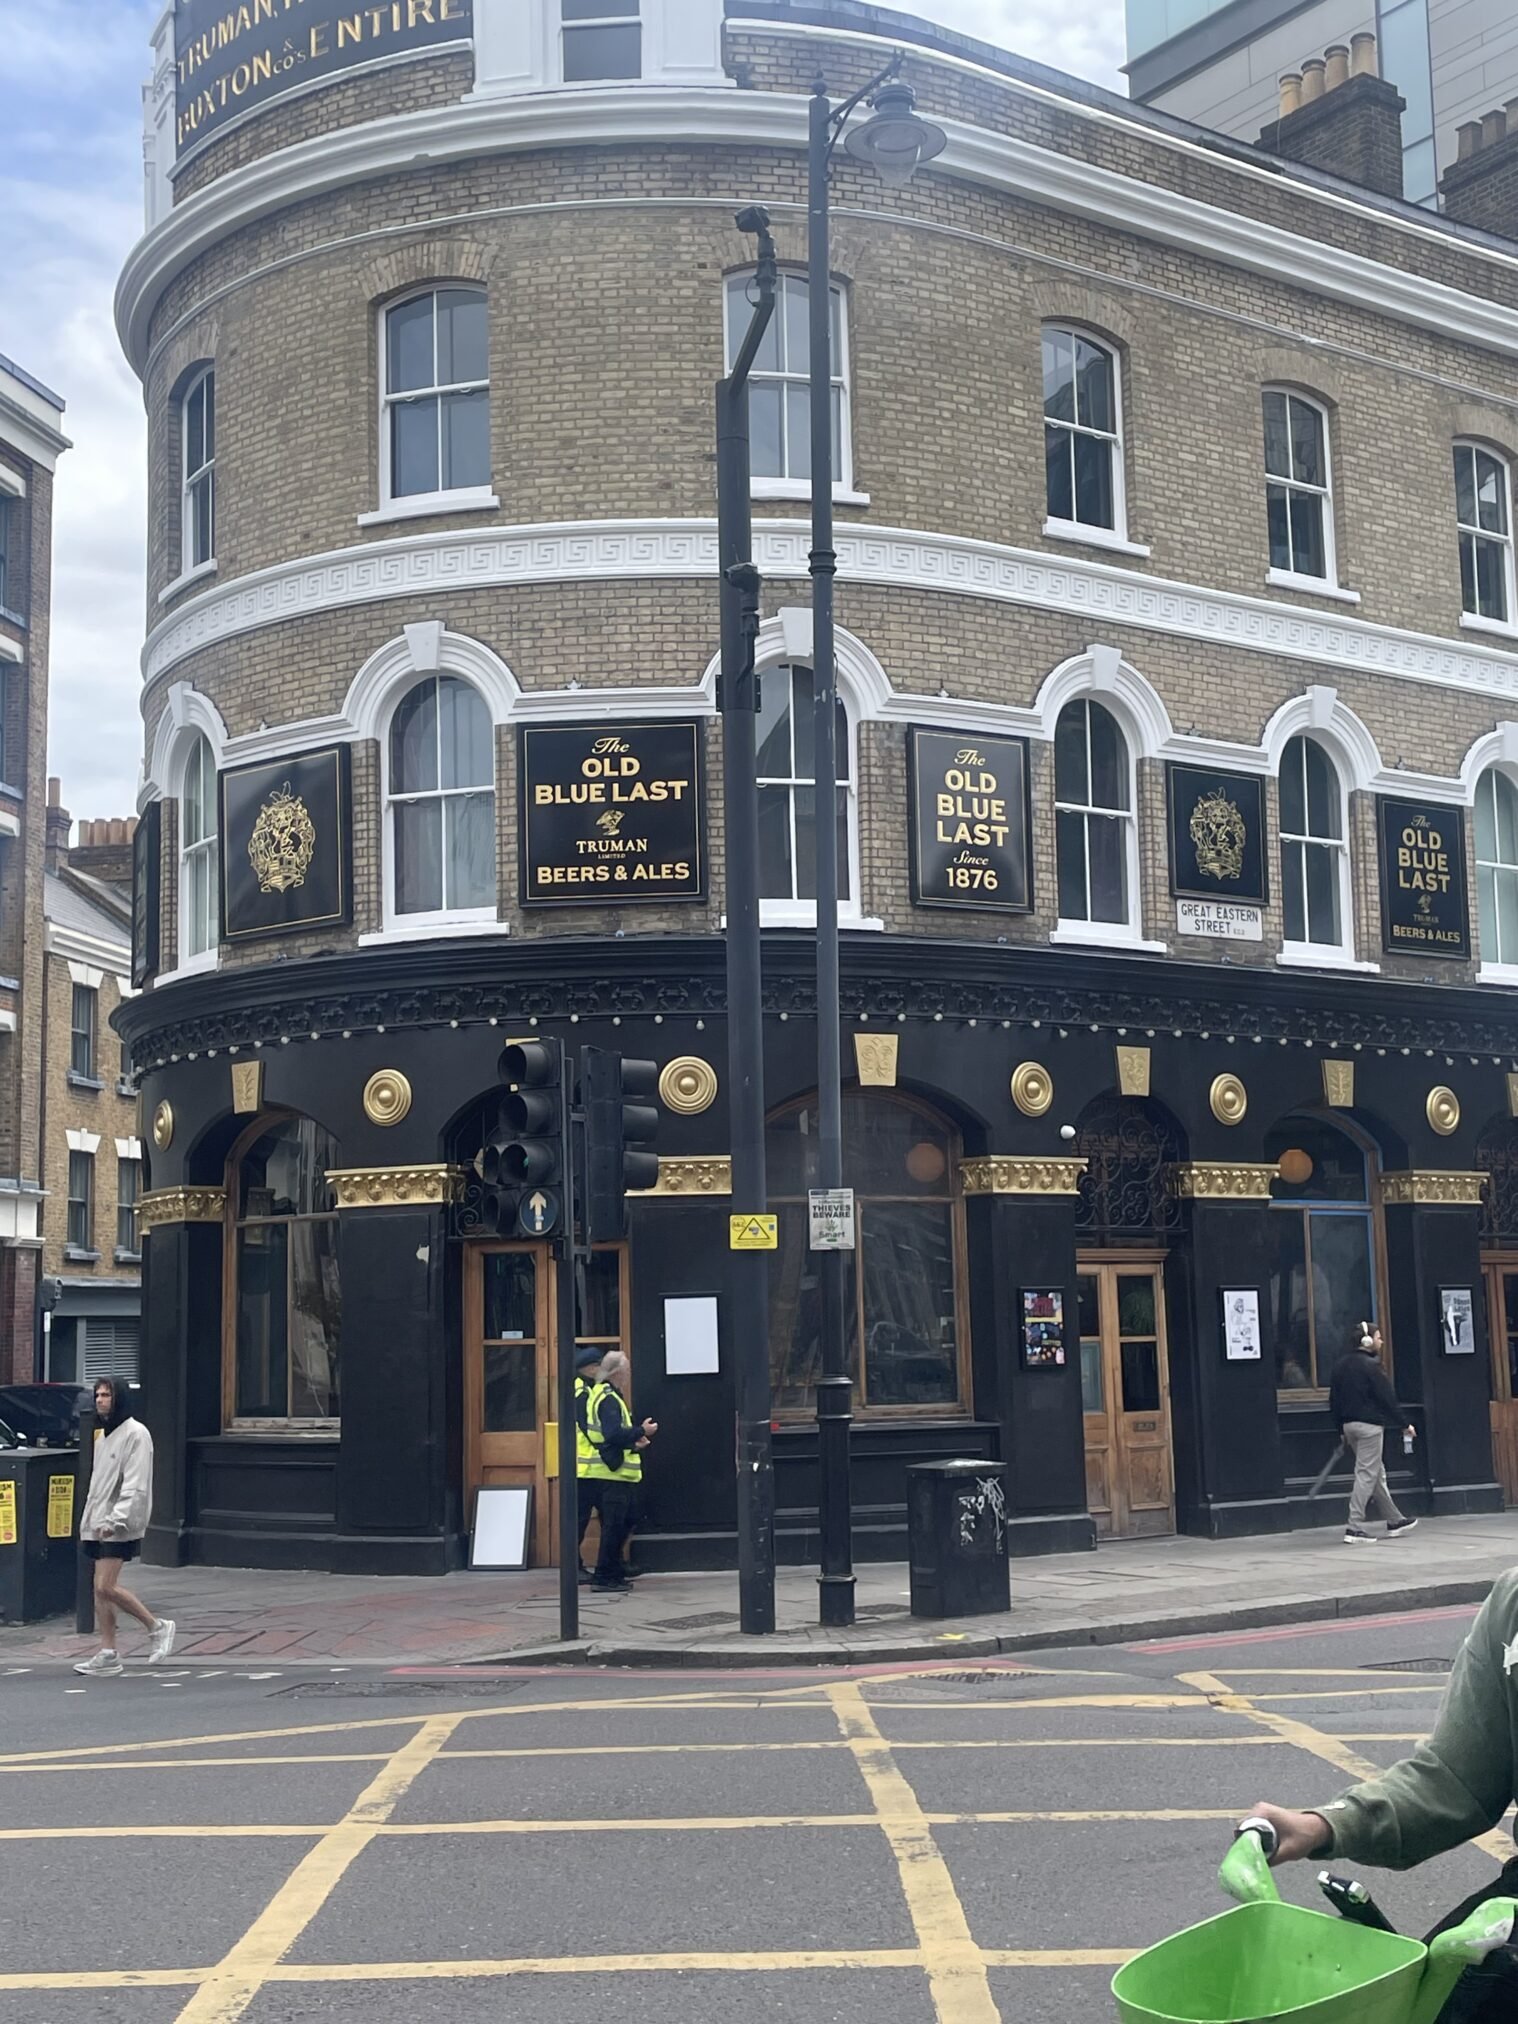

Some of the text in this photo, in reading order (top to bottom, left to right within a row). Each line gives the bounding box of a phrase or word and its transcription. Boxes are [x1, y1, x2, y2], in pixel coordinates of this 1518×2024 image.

[591, 736, 630, 755] The
[954, 749, 986, 766] The
[581, 757, 641, 778] OLD
[944, 770, 997, 794] OLD
[535, 780, 688, 805] BLUE LAST
[937, 794, 1007, 822] BLUE
[1410, 815, 1431, 828] The
[936, 820, 1009, 847] LAST
[1402, 828, 1442, 850] OLD
[576, 838, 648, 853] TRUMAN
[953, 850, 989, 865] Since
[1398, 848, 1449, 872] BLUE
[537, 862, 690, 884] BEERS & ALES
[945, 867, 998, 890] 1876
[1399, 870, 1450, 893] LAST
[1181, 904, 1258, 922] GREAT EASTERN
[1194, 918, 1231, 934] STREET
[1393, 925, 1460, 943] BEERS & ALES
[812, 1204, 851, 1212] THIEVES
[812, 1211, 851, 1219] BEWARE
[818, 1230, 845, 1239] Smart
